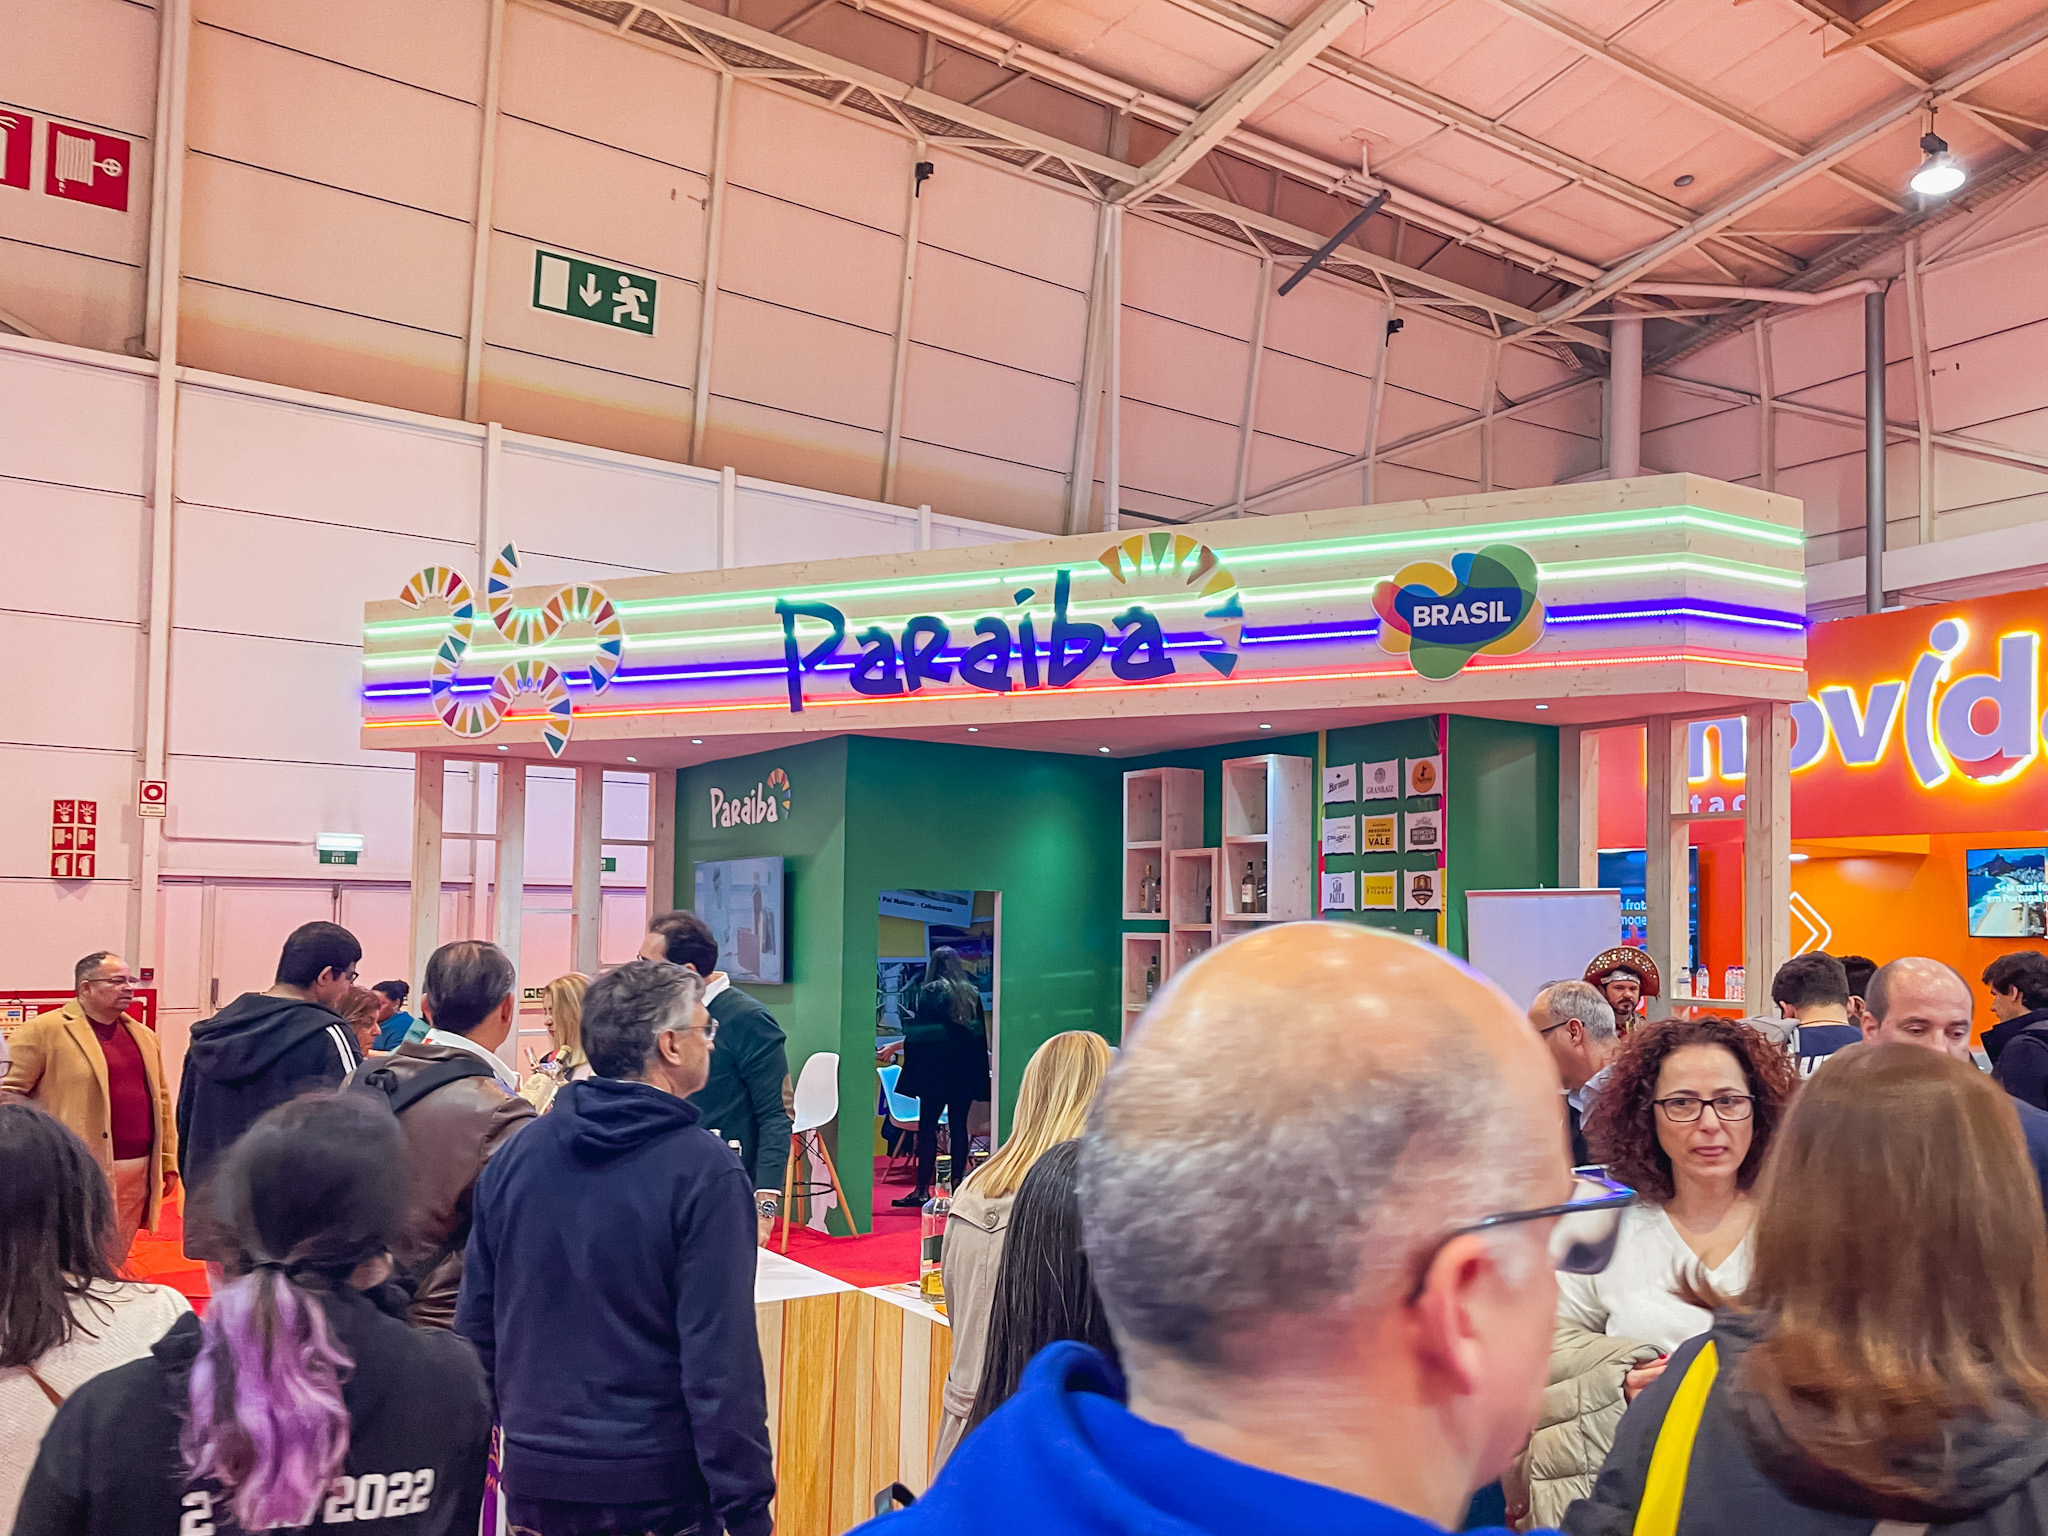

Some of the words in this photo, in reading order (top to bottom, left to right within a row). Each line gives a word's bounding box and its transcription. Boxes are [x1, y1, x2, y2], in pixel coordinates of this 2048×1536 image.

[1413, 601, 1511, 628] BRASIL
[1368, 837, 1391, 846] VALE
[2016, 882, 2037, 893] qual
[2003, 893, 2042, 904] Portugal
[1626, 898, 1647, 911] frot
